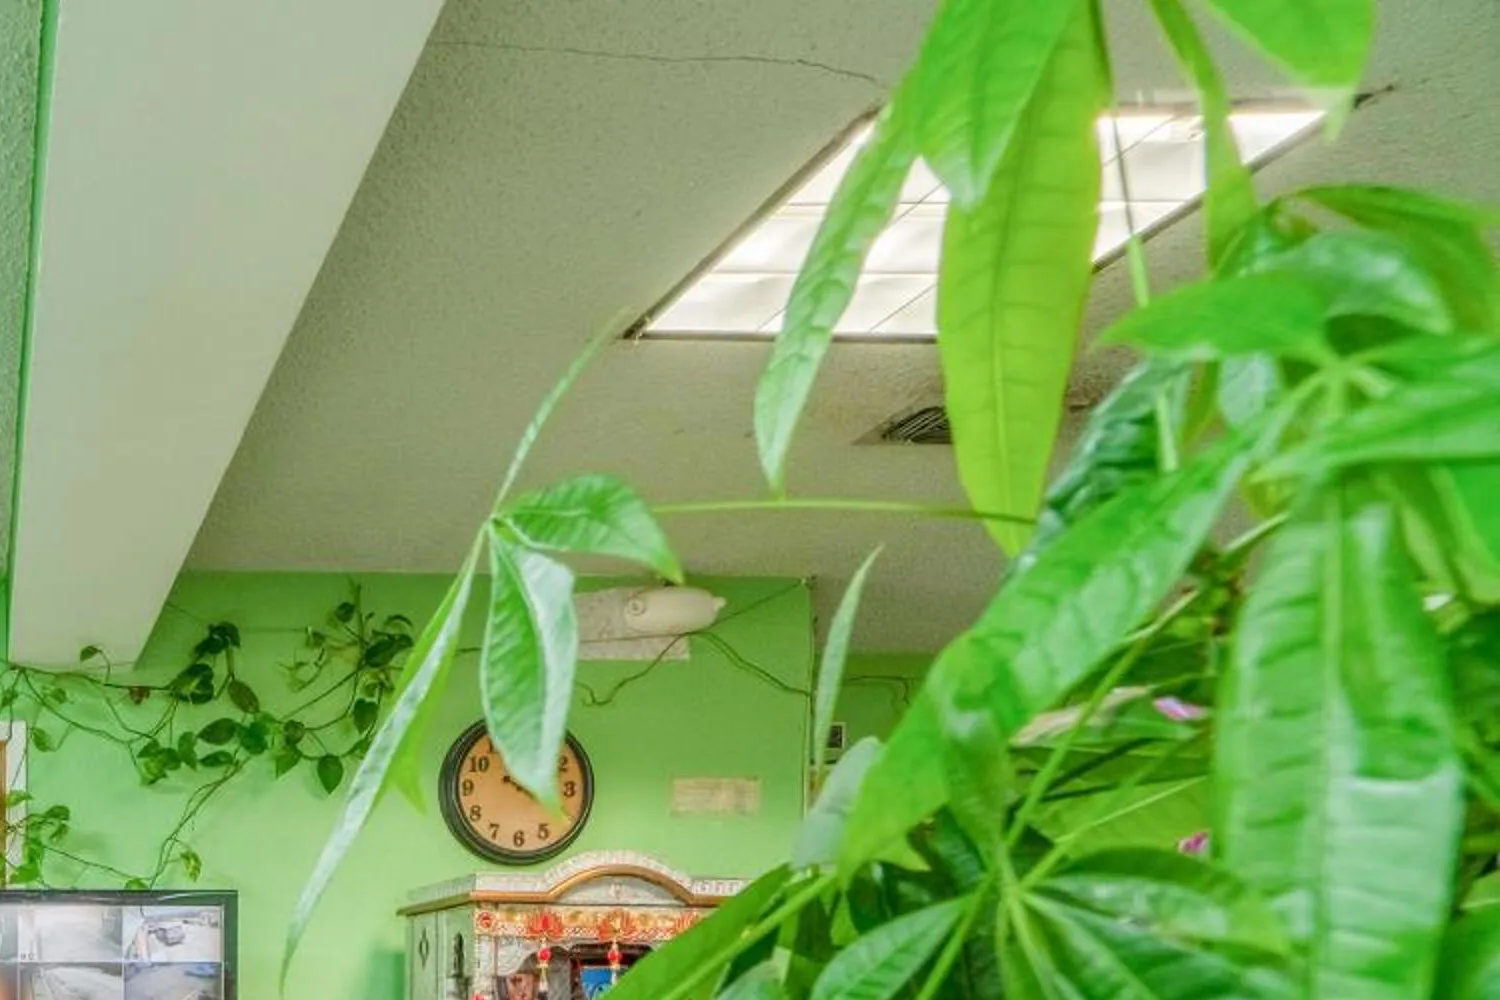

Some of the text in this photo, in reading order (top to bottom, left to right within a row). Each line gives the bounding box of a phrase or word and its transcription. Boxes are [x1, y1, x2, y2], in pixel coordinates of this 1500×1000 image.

[469, 756, 490, 772] 10
[559, 755, 568, 772] 2
[462, 779, 474, 796] 9
[564, 781, 575, 798] 3
[470, 805, 481, 821] 8
[489, 823, 500, 840] 7
[514, 830, 525, 847] 6
[538, 823, 549, 840] 5
